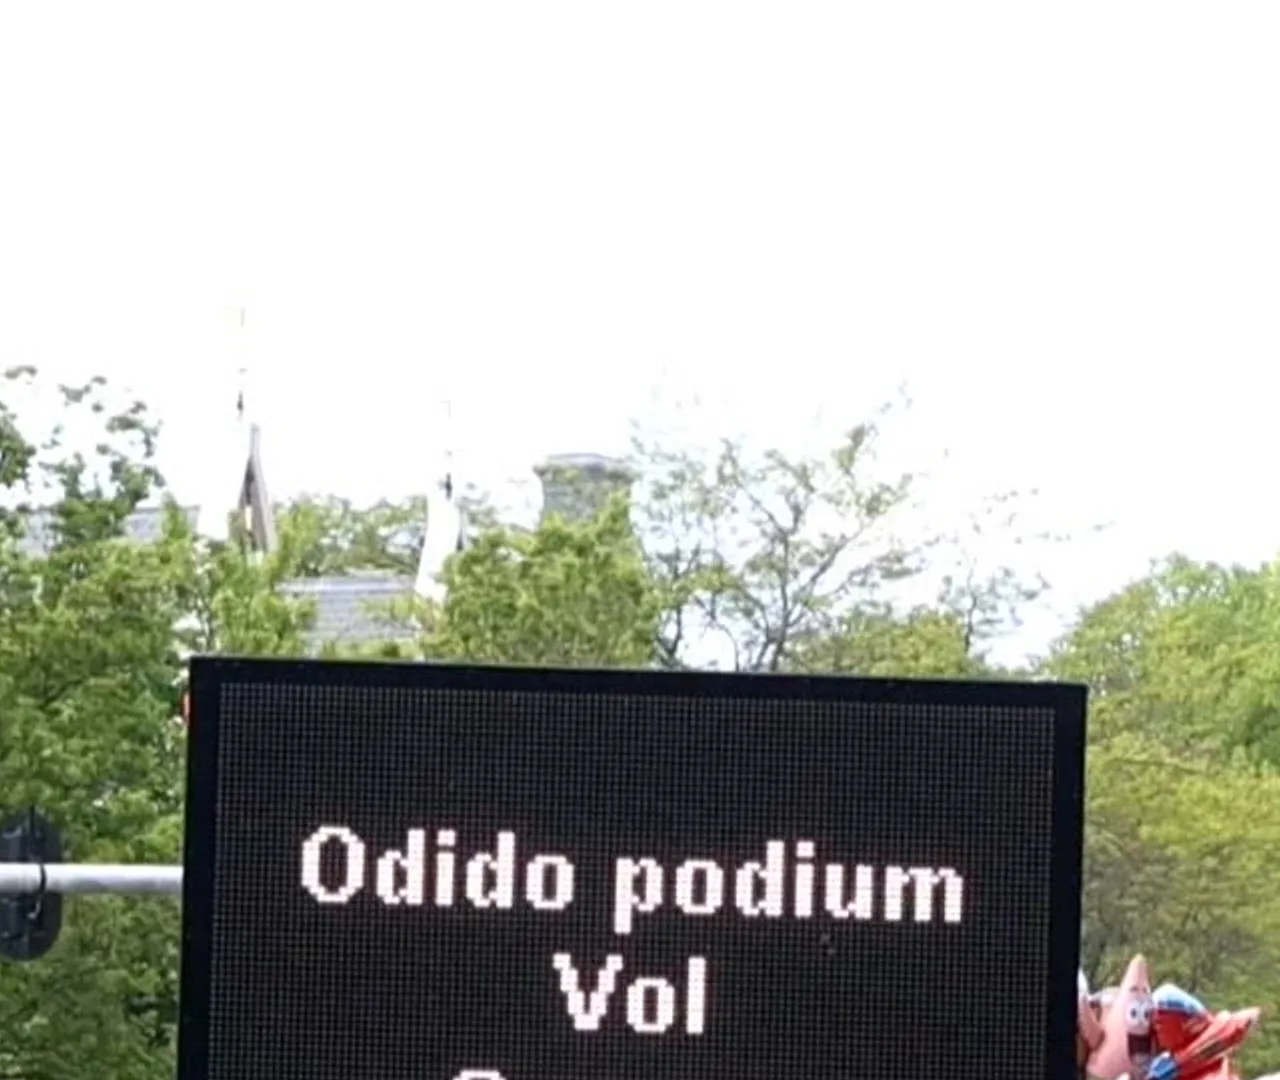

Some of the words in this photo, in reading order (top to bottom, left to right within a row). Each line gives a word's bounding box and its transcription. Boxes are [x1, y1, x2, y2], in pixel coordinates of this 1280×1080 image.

[301, 825, 575, 910] Odido
[614, 840, 964, 935] podium
[552, 952, 707, 1035] Vol
